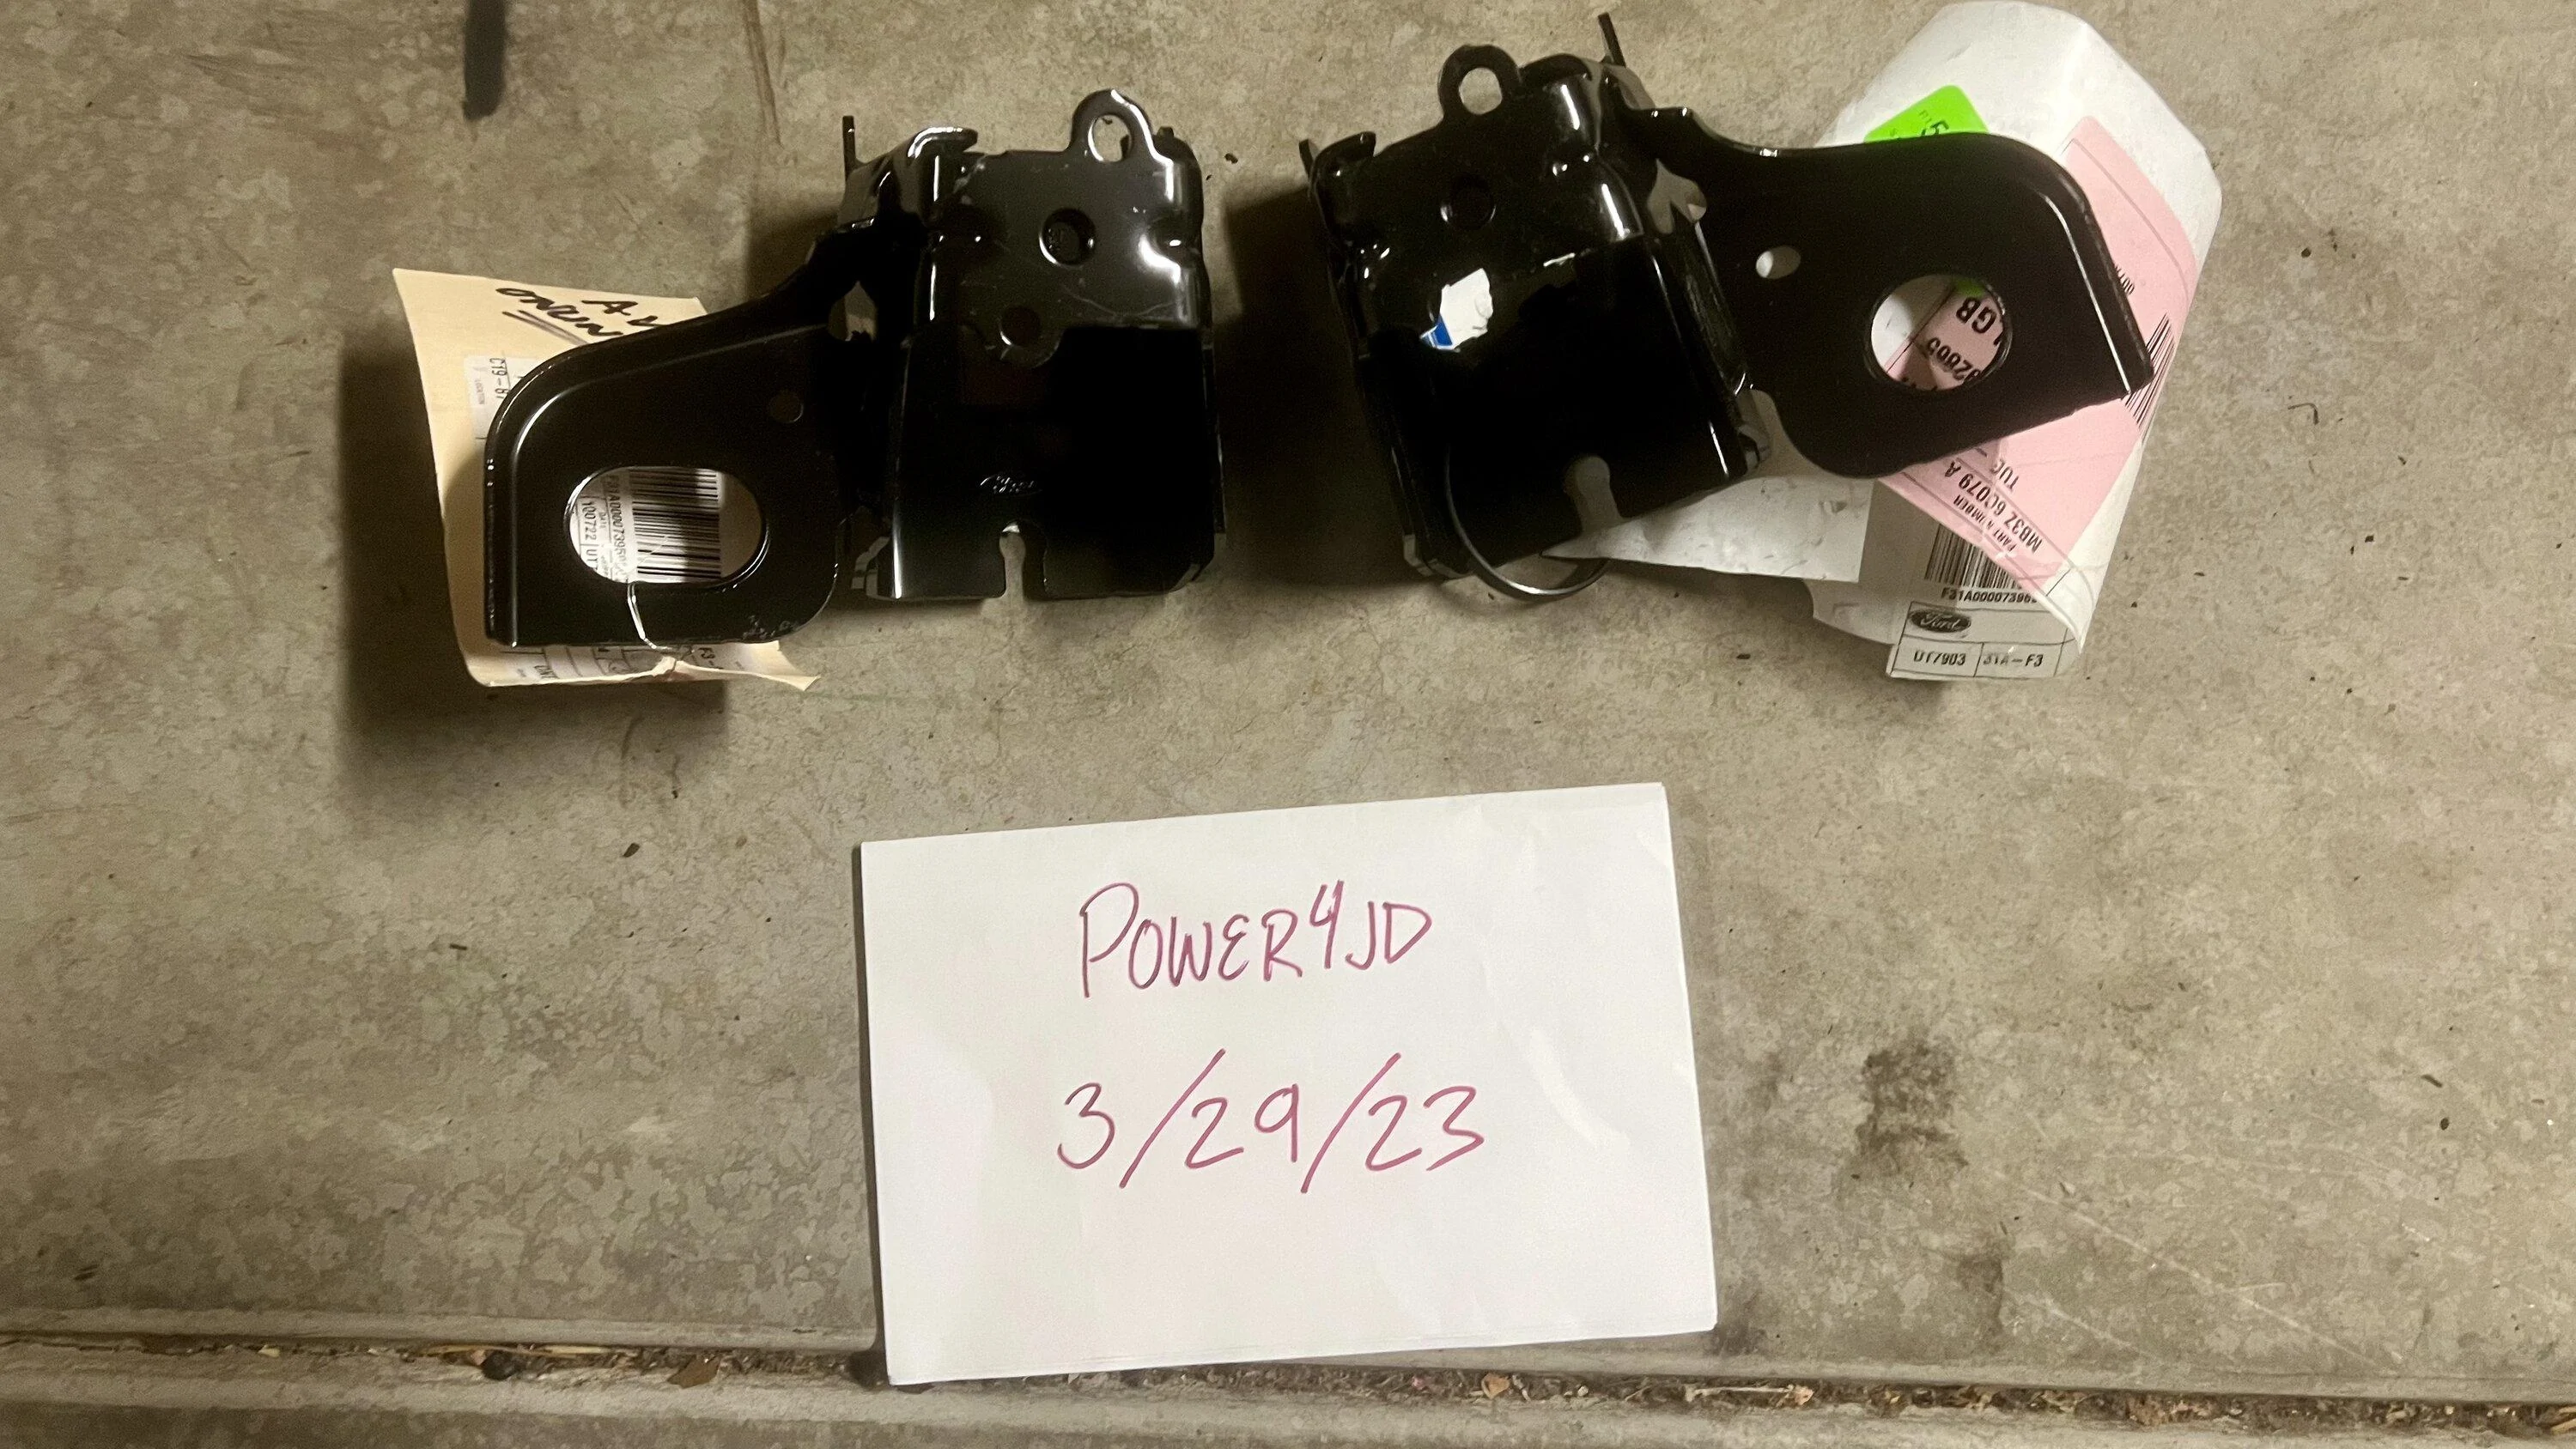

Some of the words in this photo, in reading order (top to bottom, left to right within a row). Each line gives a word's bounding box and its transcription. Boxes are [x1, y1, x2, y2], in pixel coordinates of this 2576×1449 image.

[1956, 296, 1997, 334] GB
[1944, 461, 1962, 477] A
[581, 501, 598, 541] 100722
[1992, 529, 2017, 552] PART
[2003, 511, 2043, 554] MB3Z
[1079, 879, 1433, 998] POWER4JD
[1056, 1048, 1485, 1194] 3/29/23
